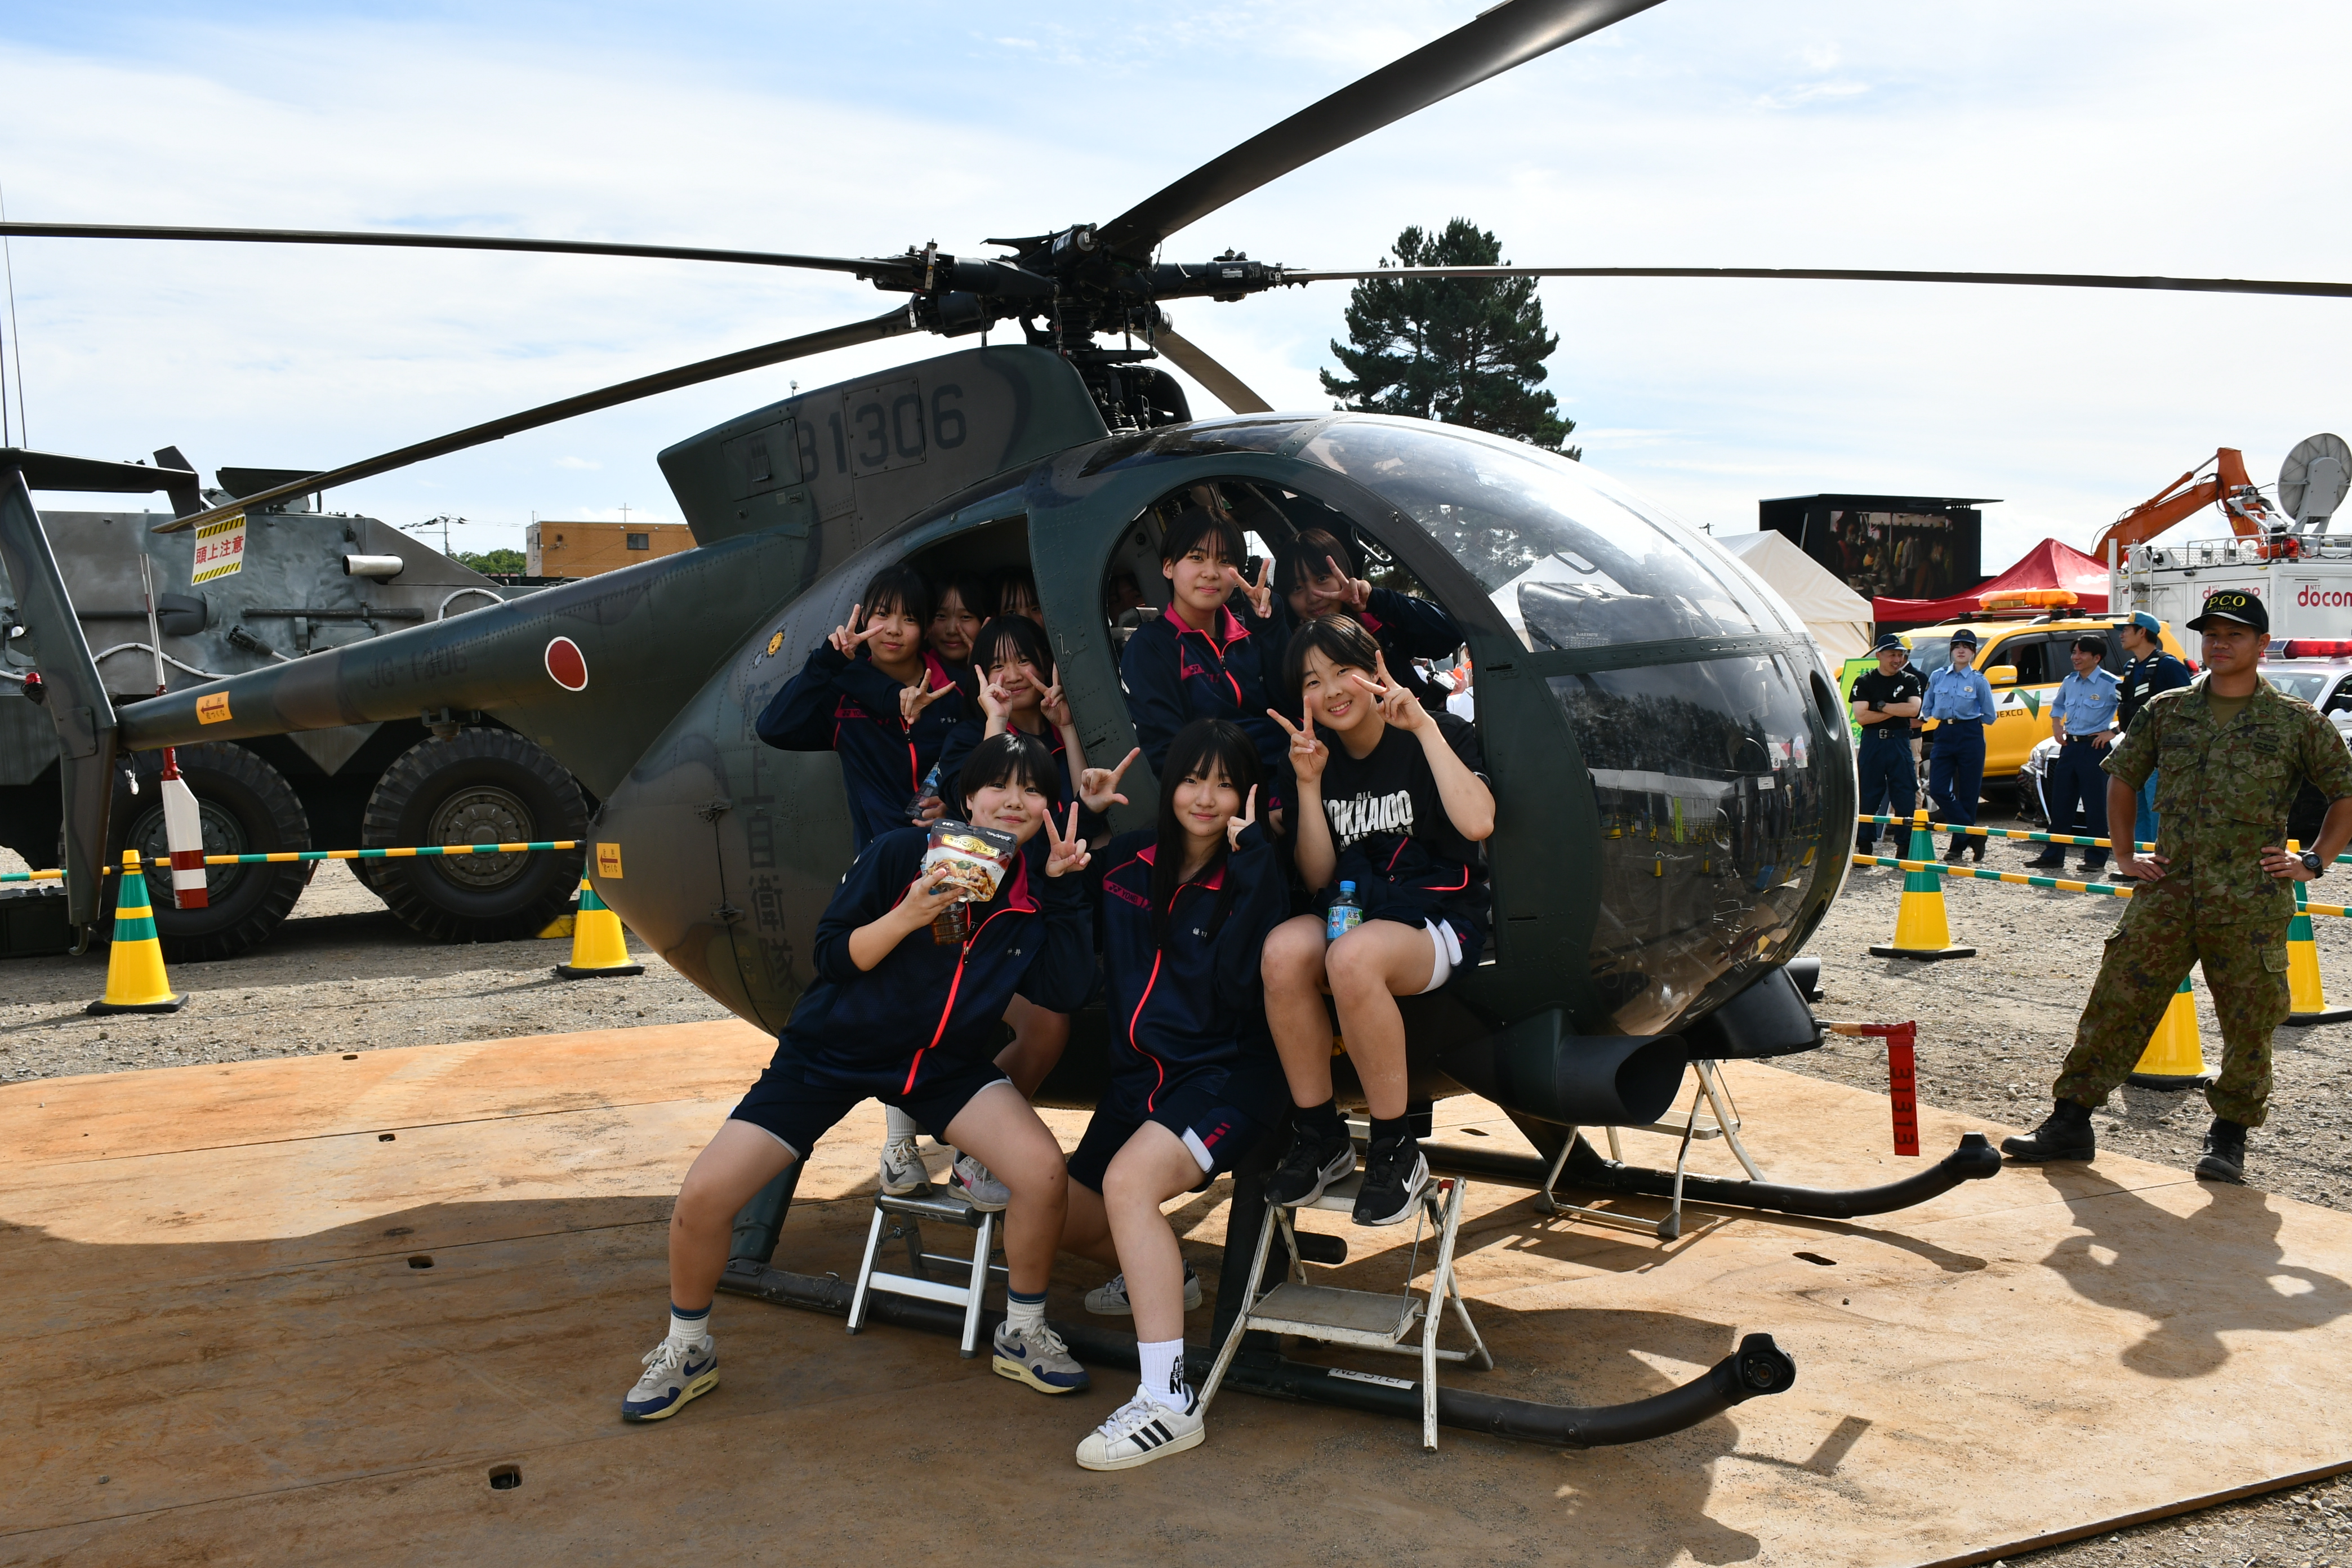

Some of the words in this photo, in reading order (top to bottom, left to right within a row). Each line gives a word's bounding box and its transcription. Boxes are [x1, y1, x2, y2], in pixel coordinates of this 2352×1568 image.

[195, 535, 244, 564] 頭上注意
[2207, 595, 2246, 609] PCO
[1356, 791, 1373, 801] ALL
[1170, 1378, 1184, 1394] N
